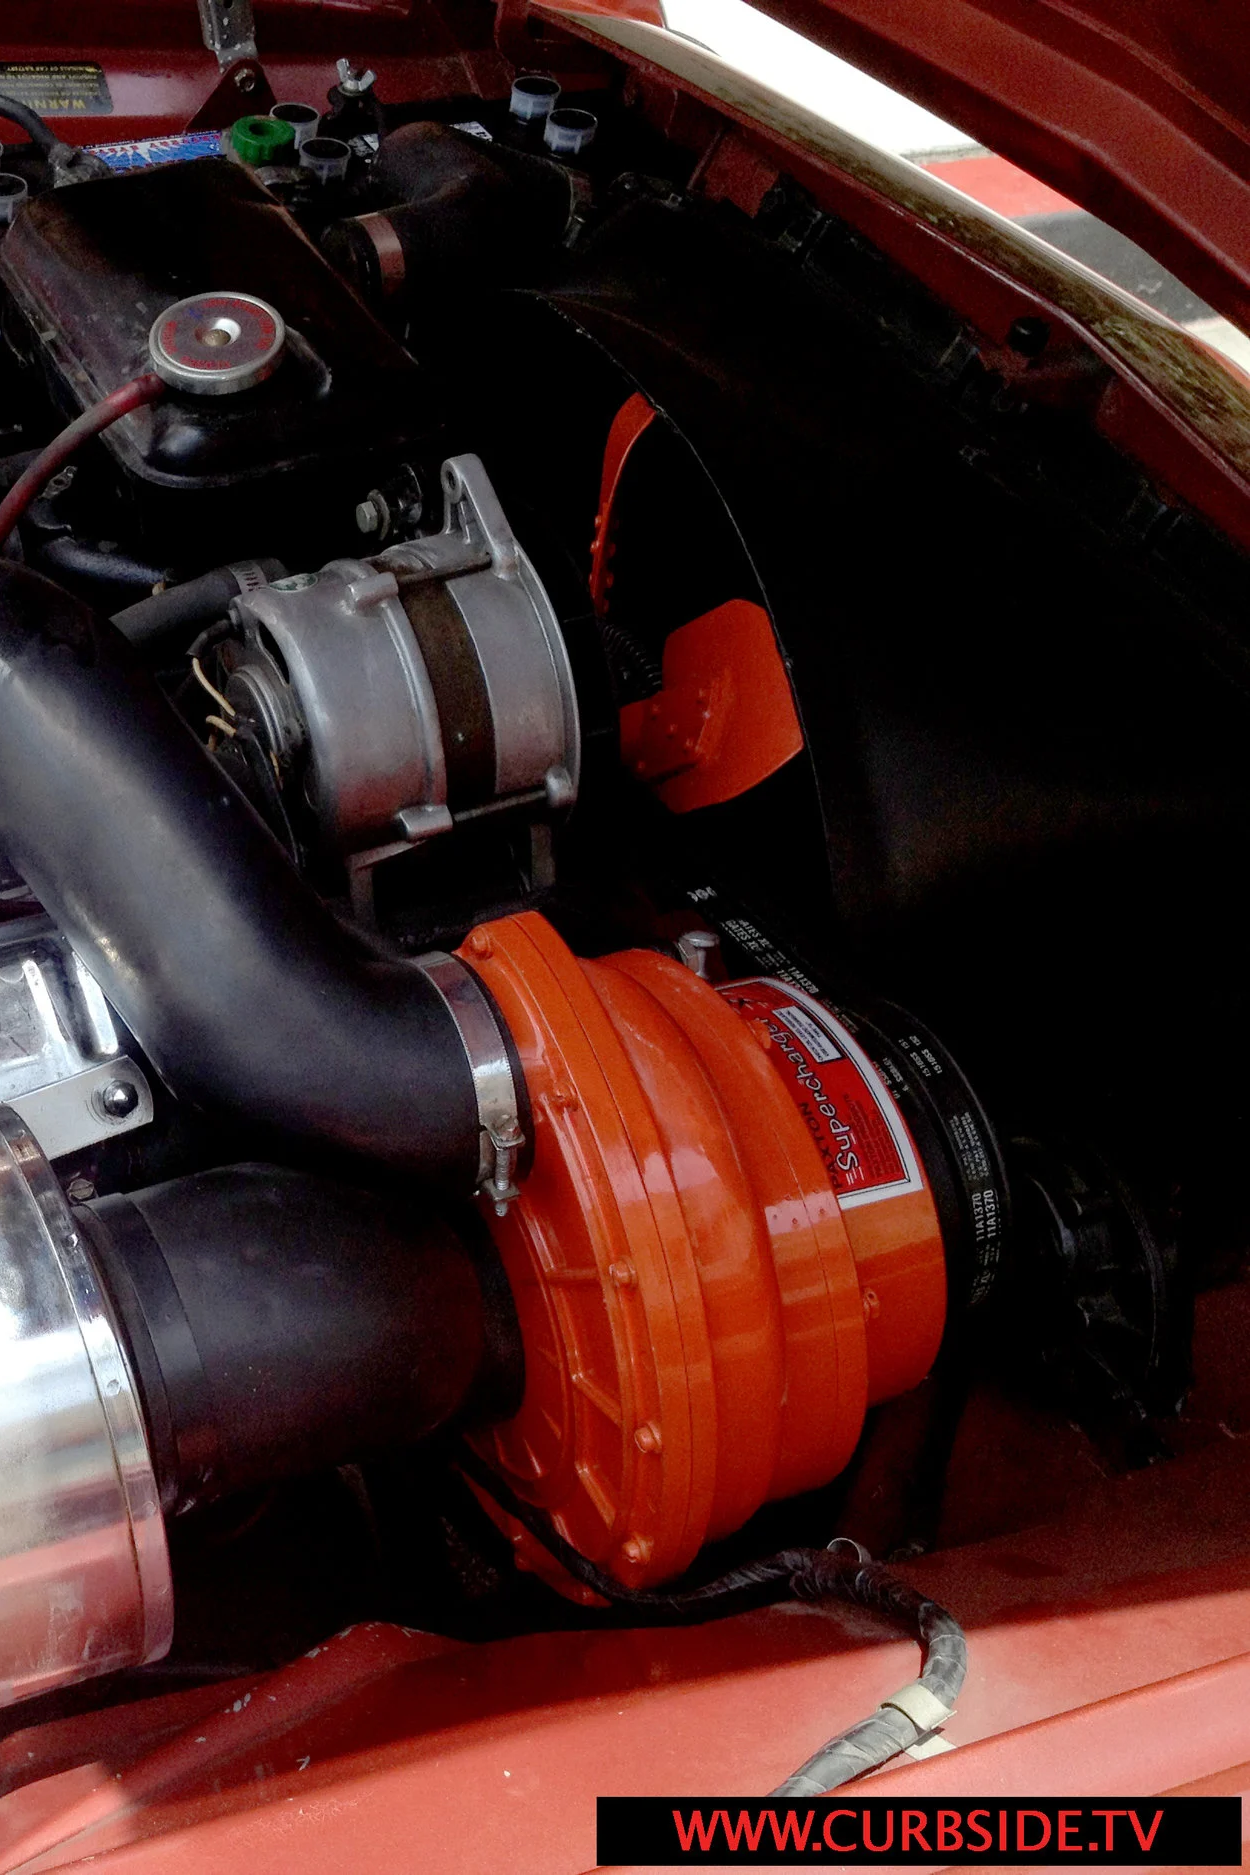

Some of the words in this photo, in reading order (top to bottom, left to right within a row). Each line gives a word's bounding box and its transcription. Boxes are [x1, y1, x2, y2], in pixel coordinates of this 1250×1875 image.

[23, 99, 86, 109] WARNI
[756, 1017, 859, 1171] Supercharger
[799, 1101, 843, 1189] PAXTON
[971, 1192, 986, 1242] 11A1370
[983, 1188, 998, 1239] 11A1370
